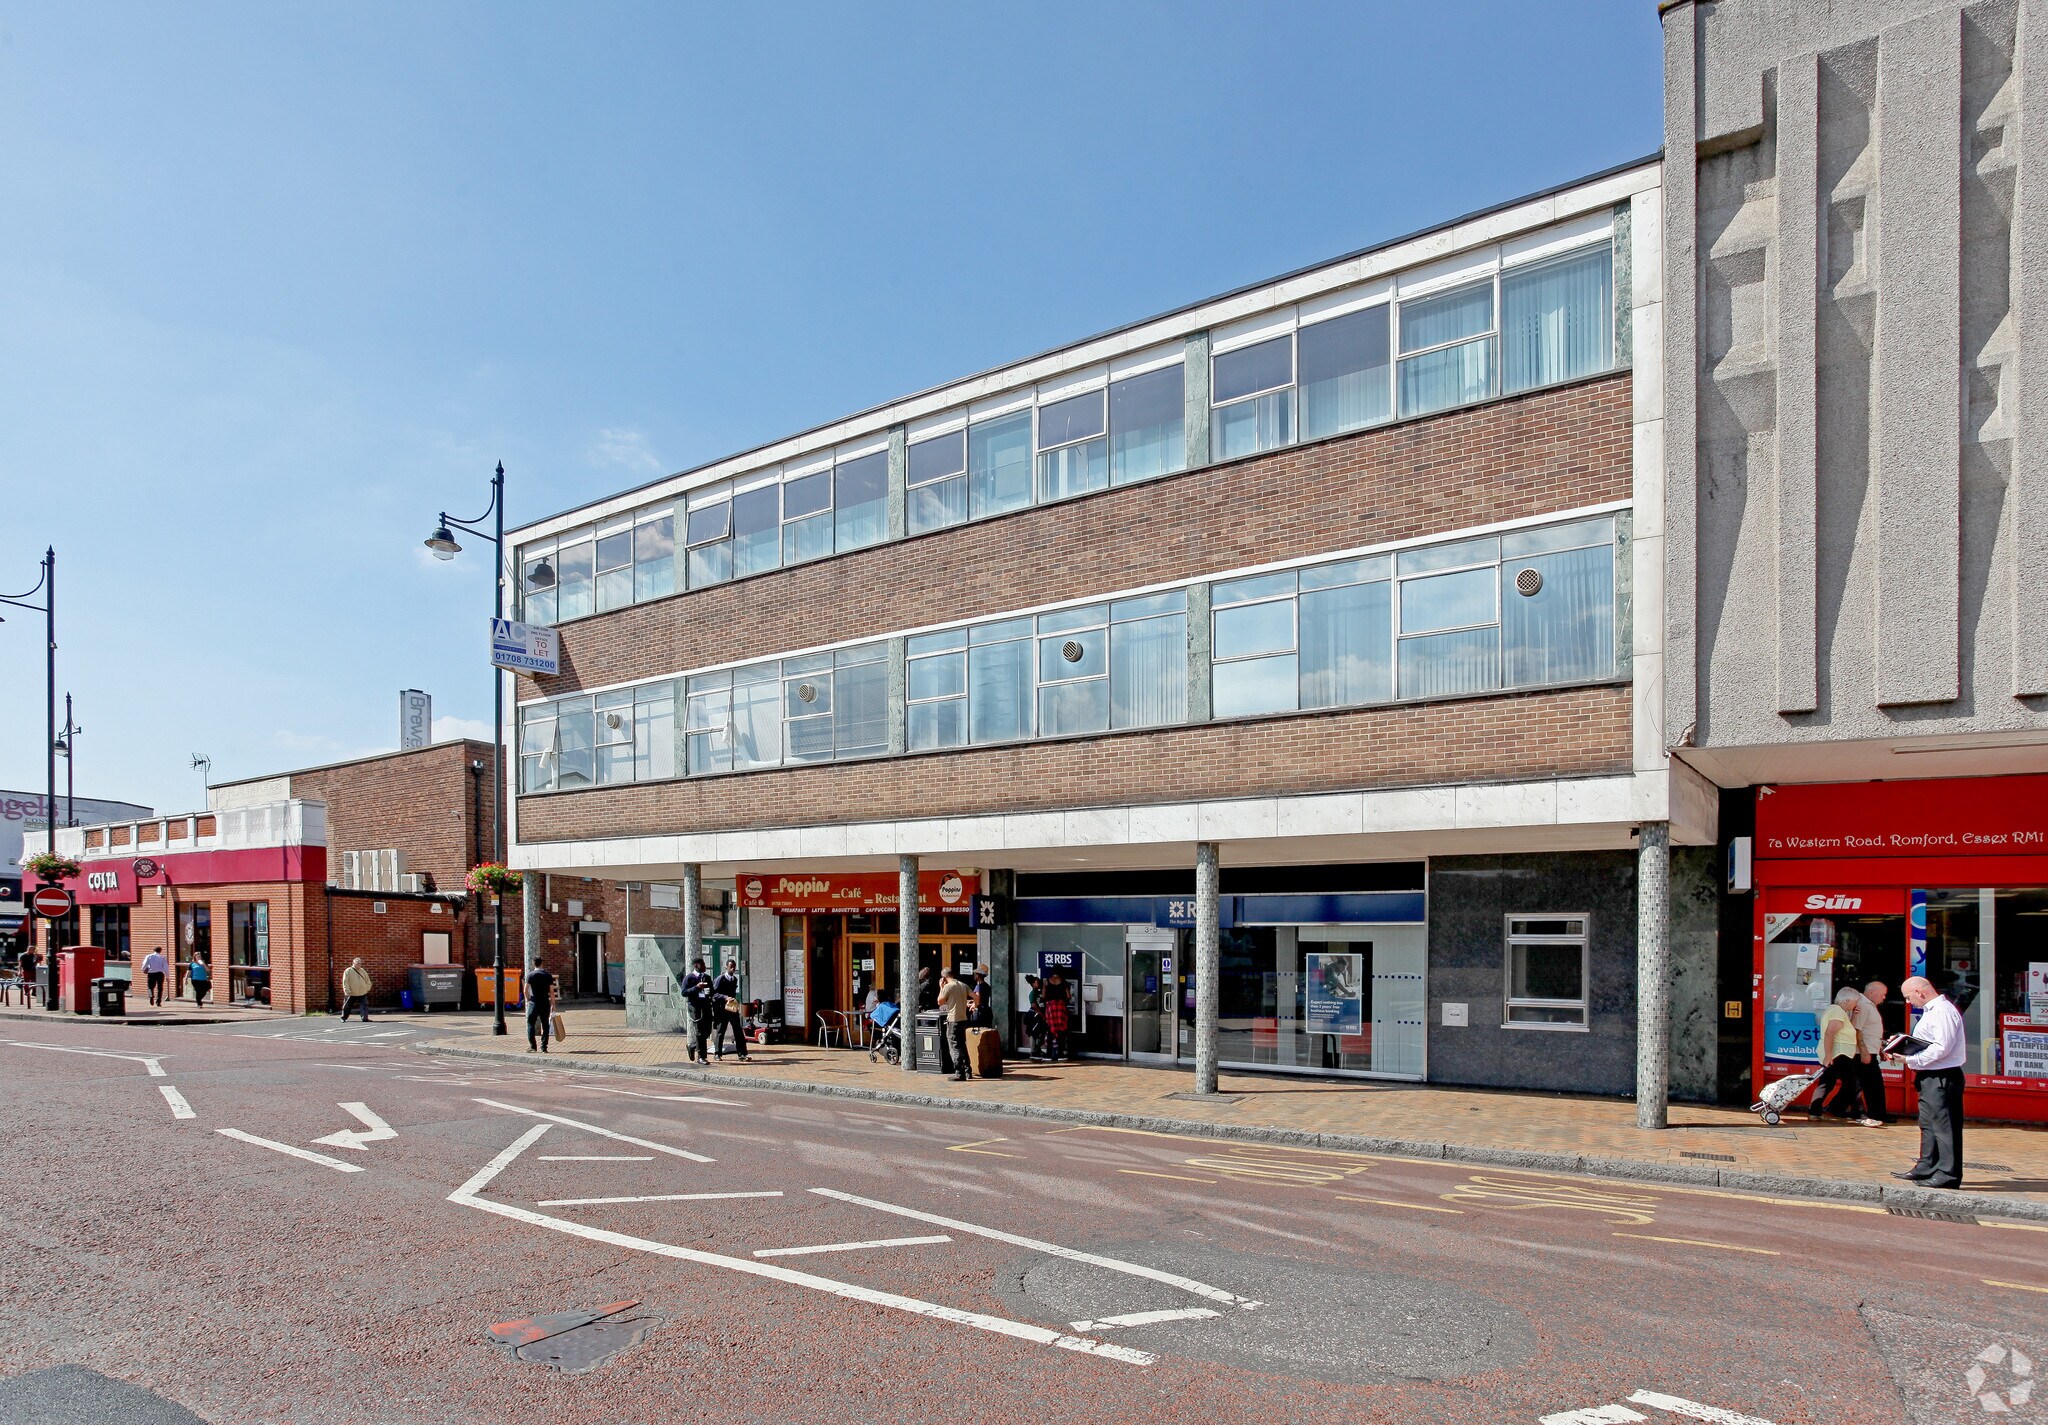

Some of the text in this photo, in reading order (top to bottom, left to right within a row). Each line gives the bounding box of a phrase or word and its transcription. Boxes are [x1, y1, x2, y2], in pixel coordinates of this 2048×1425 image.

[493, 619, 526, 642] AC
[536, 641, 547, 649] TO
[495, 652, 521, 663] 01708
[524, 657, 555, 668] 731200
[533, 649, 549, 657] LET
[411, 696, 425, 748] Brewe
[1768, 831, 2044, 848] 7a Western Road, Romford, Essex RM1
[88, 872, 118, 890] COSTA
[779, 877, 830, 898] Poppins
[841, 888, 861, 899] Café
[875, 893, 927, 904] Restant
[1804, 895, 1862, 910] Sun
[1054, 953, 1072, 964] RBS
[785, 987, 804, 995] poppins
[1727, 1002, 1739, 1016] H
[1779, 1027, 1820, 1044] oyst
[1777, 1046, 1817, 1054] availabl
[2014, 1060, 2044, 1069] AT BANK
[1438, 1175, 1662, 1226] BUS
